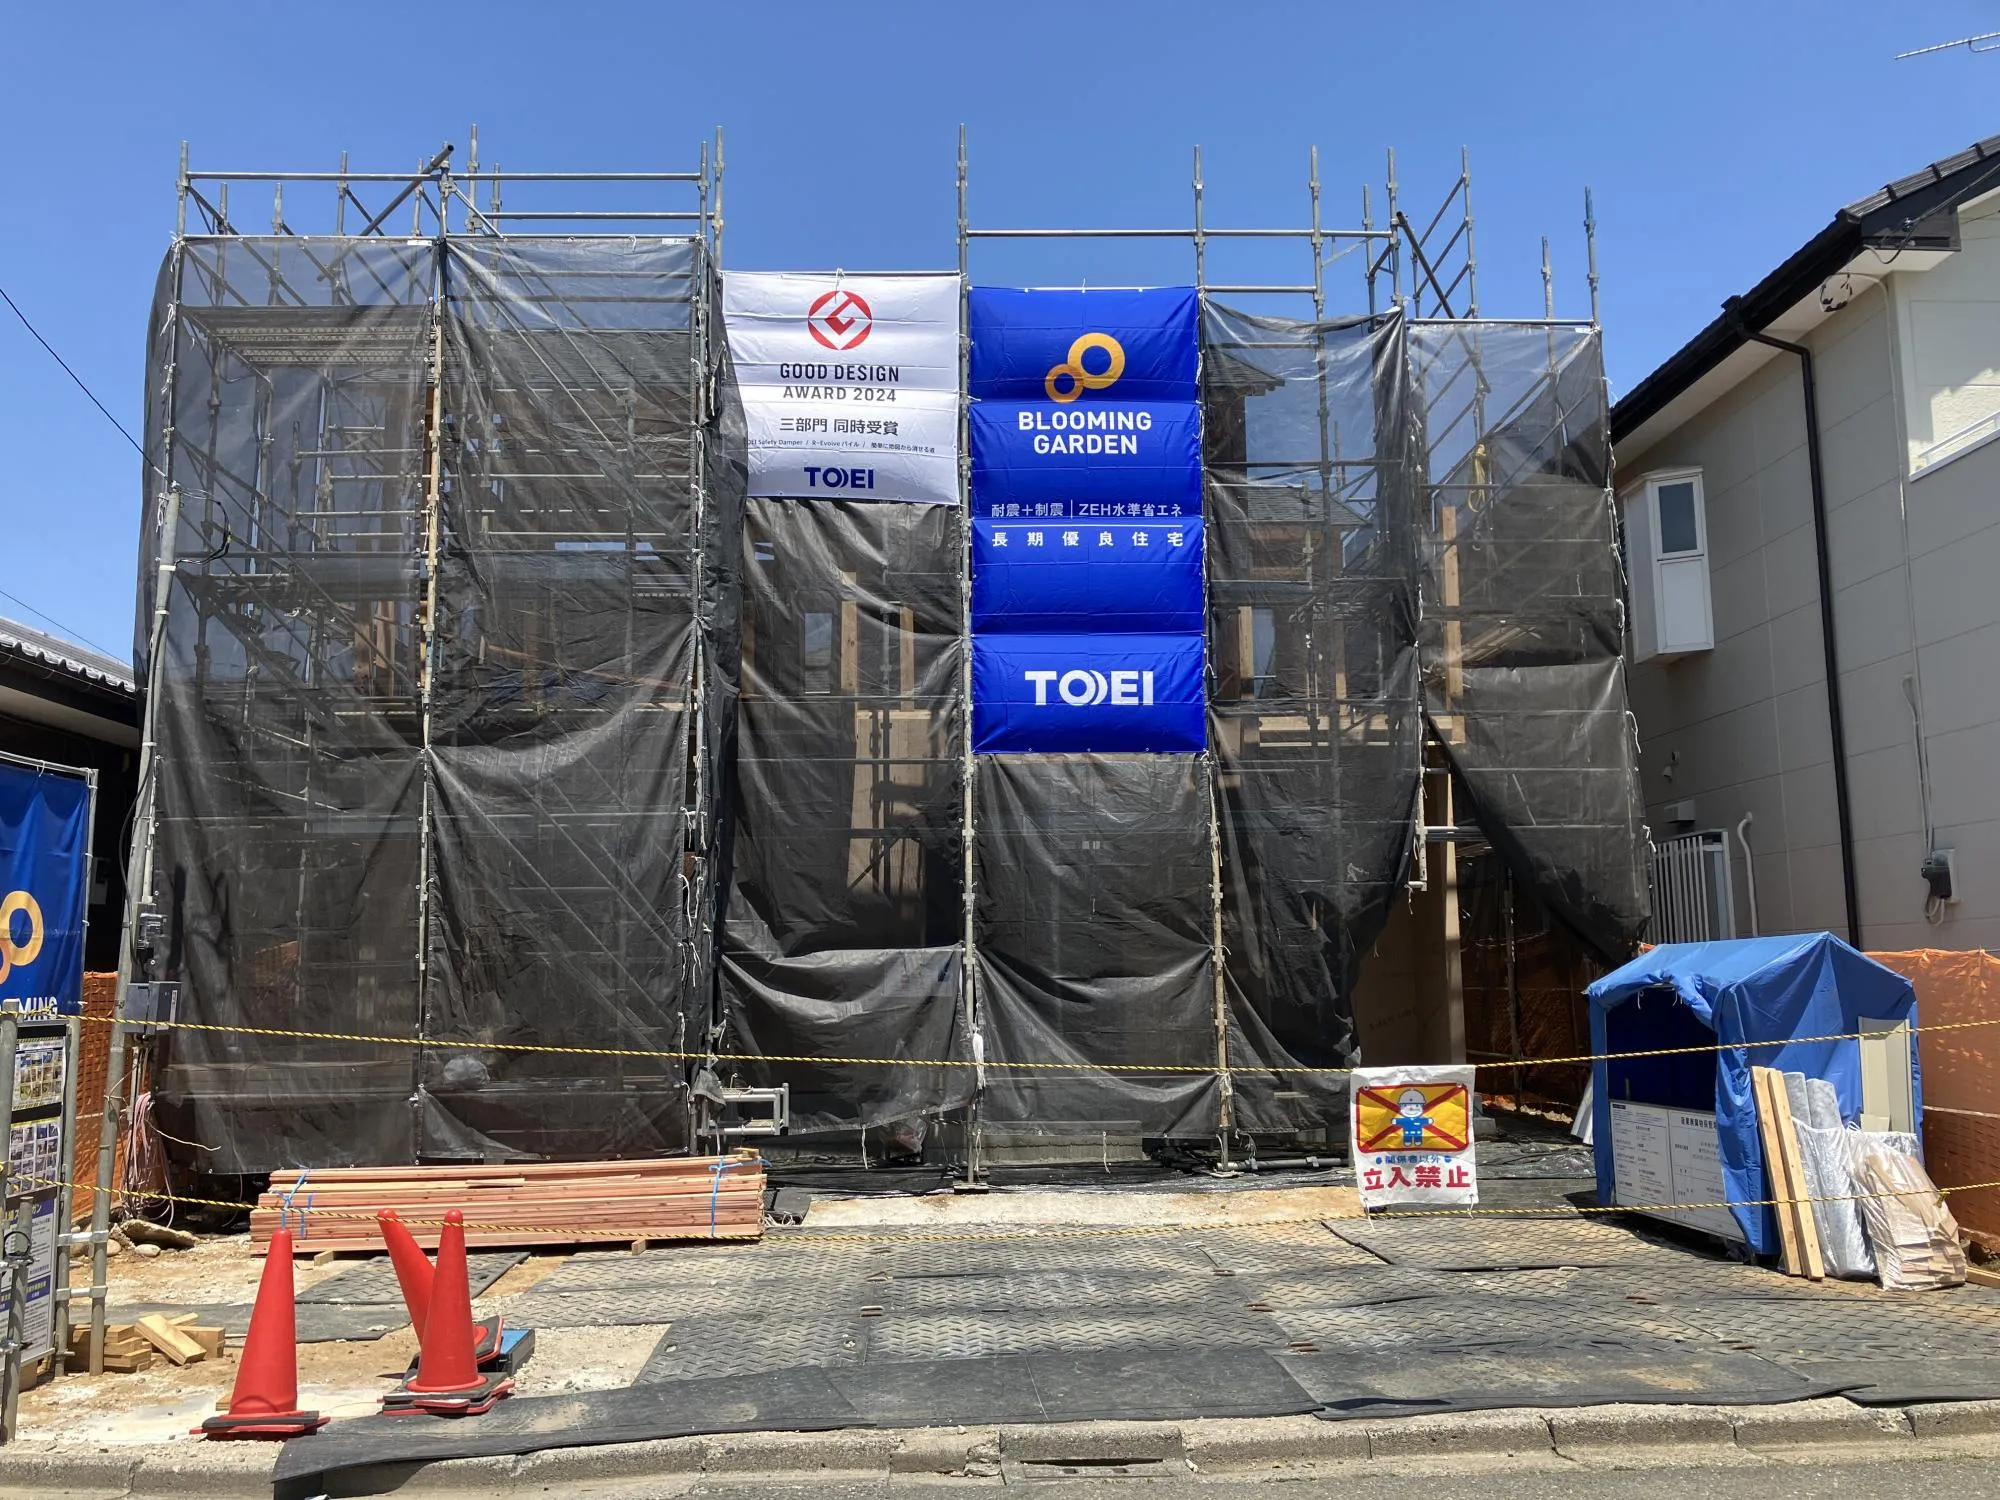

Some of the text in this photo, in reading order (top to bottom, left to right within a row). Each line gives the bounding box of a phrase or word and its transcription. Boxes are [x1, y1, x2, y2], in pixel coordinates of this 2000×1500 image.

[780, 363, 899, 382] GOOD DESIGN
[783, 386, 897, 402] AWARD 2024
[780, 418, 899, 437] 三部門 同時受賞
[1018, 411, 1152, 431] BLOOMING
[1033, 434, 1138, 455] GARDEN
[1078, 502, 1182, 517] ZEH水準省エネ
[991, 530, 1184, 547] 長期優良住宅
[1364, 1165, 1471, 1191] 立入禁止
